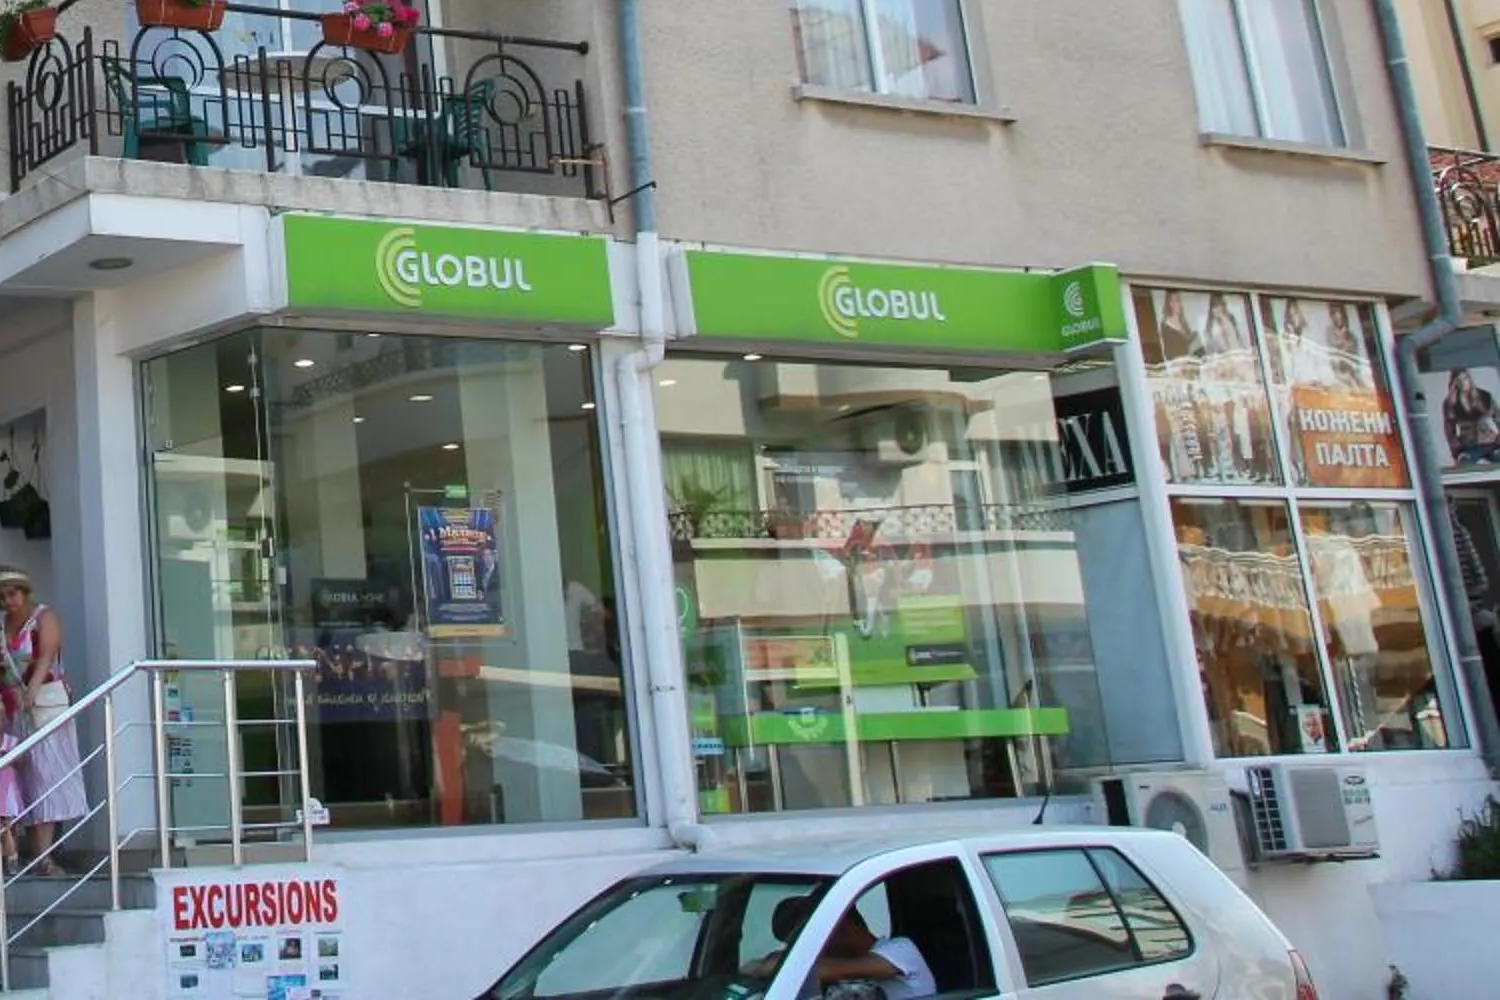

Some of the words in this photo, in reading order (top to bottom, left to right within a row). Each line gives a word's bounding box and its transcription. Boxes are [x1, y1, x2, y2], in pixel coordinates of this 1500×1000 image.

[396, 249, 533, 291] GLOBUL
[835, 286, 946, 321] GLOBUL
[1299, 407, 1393, 436] КОЖЕНИ
[1315, 442, 1391, 468] ПАЛТА
[172, 879, 339, 931] EXCURSIONS
